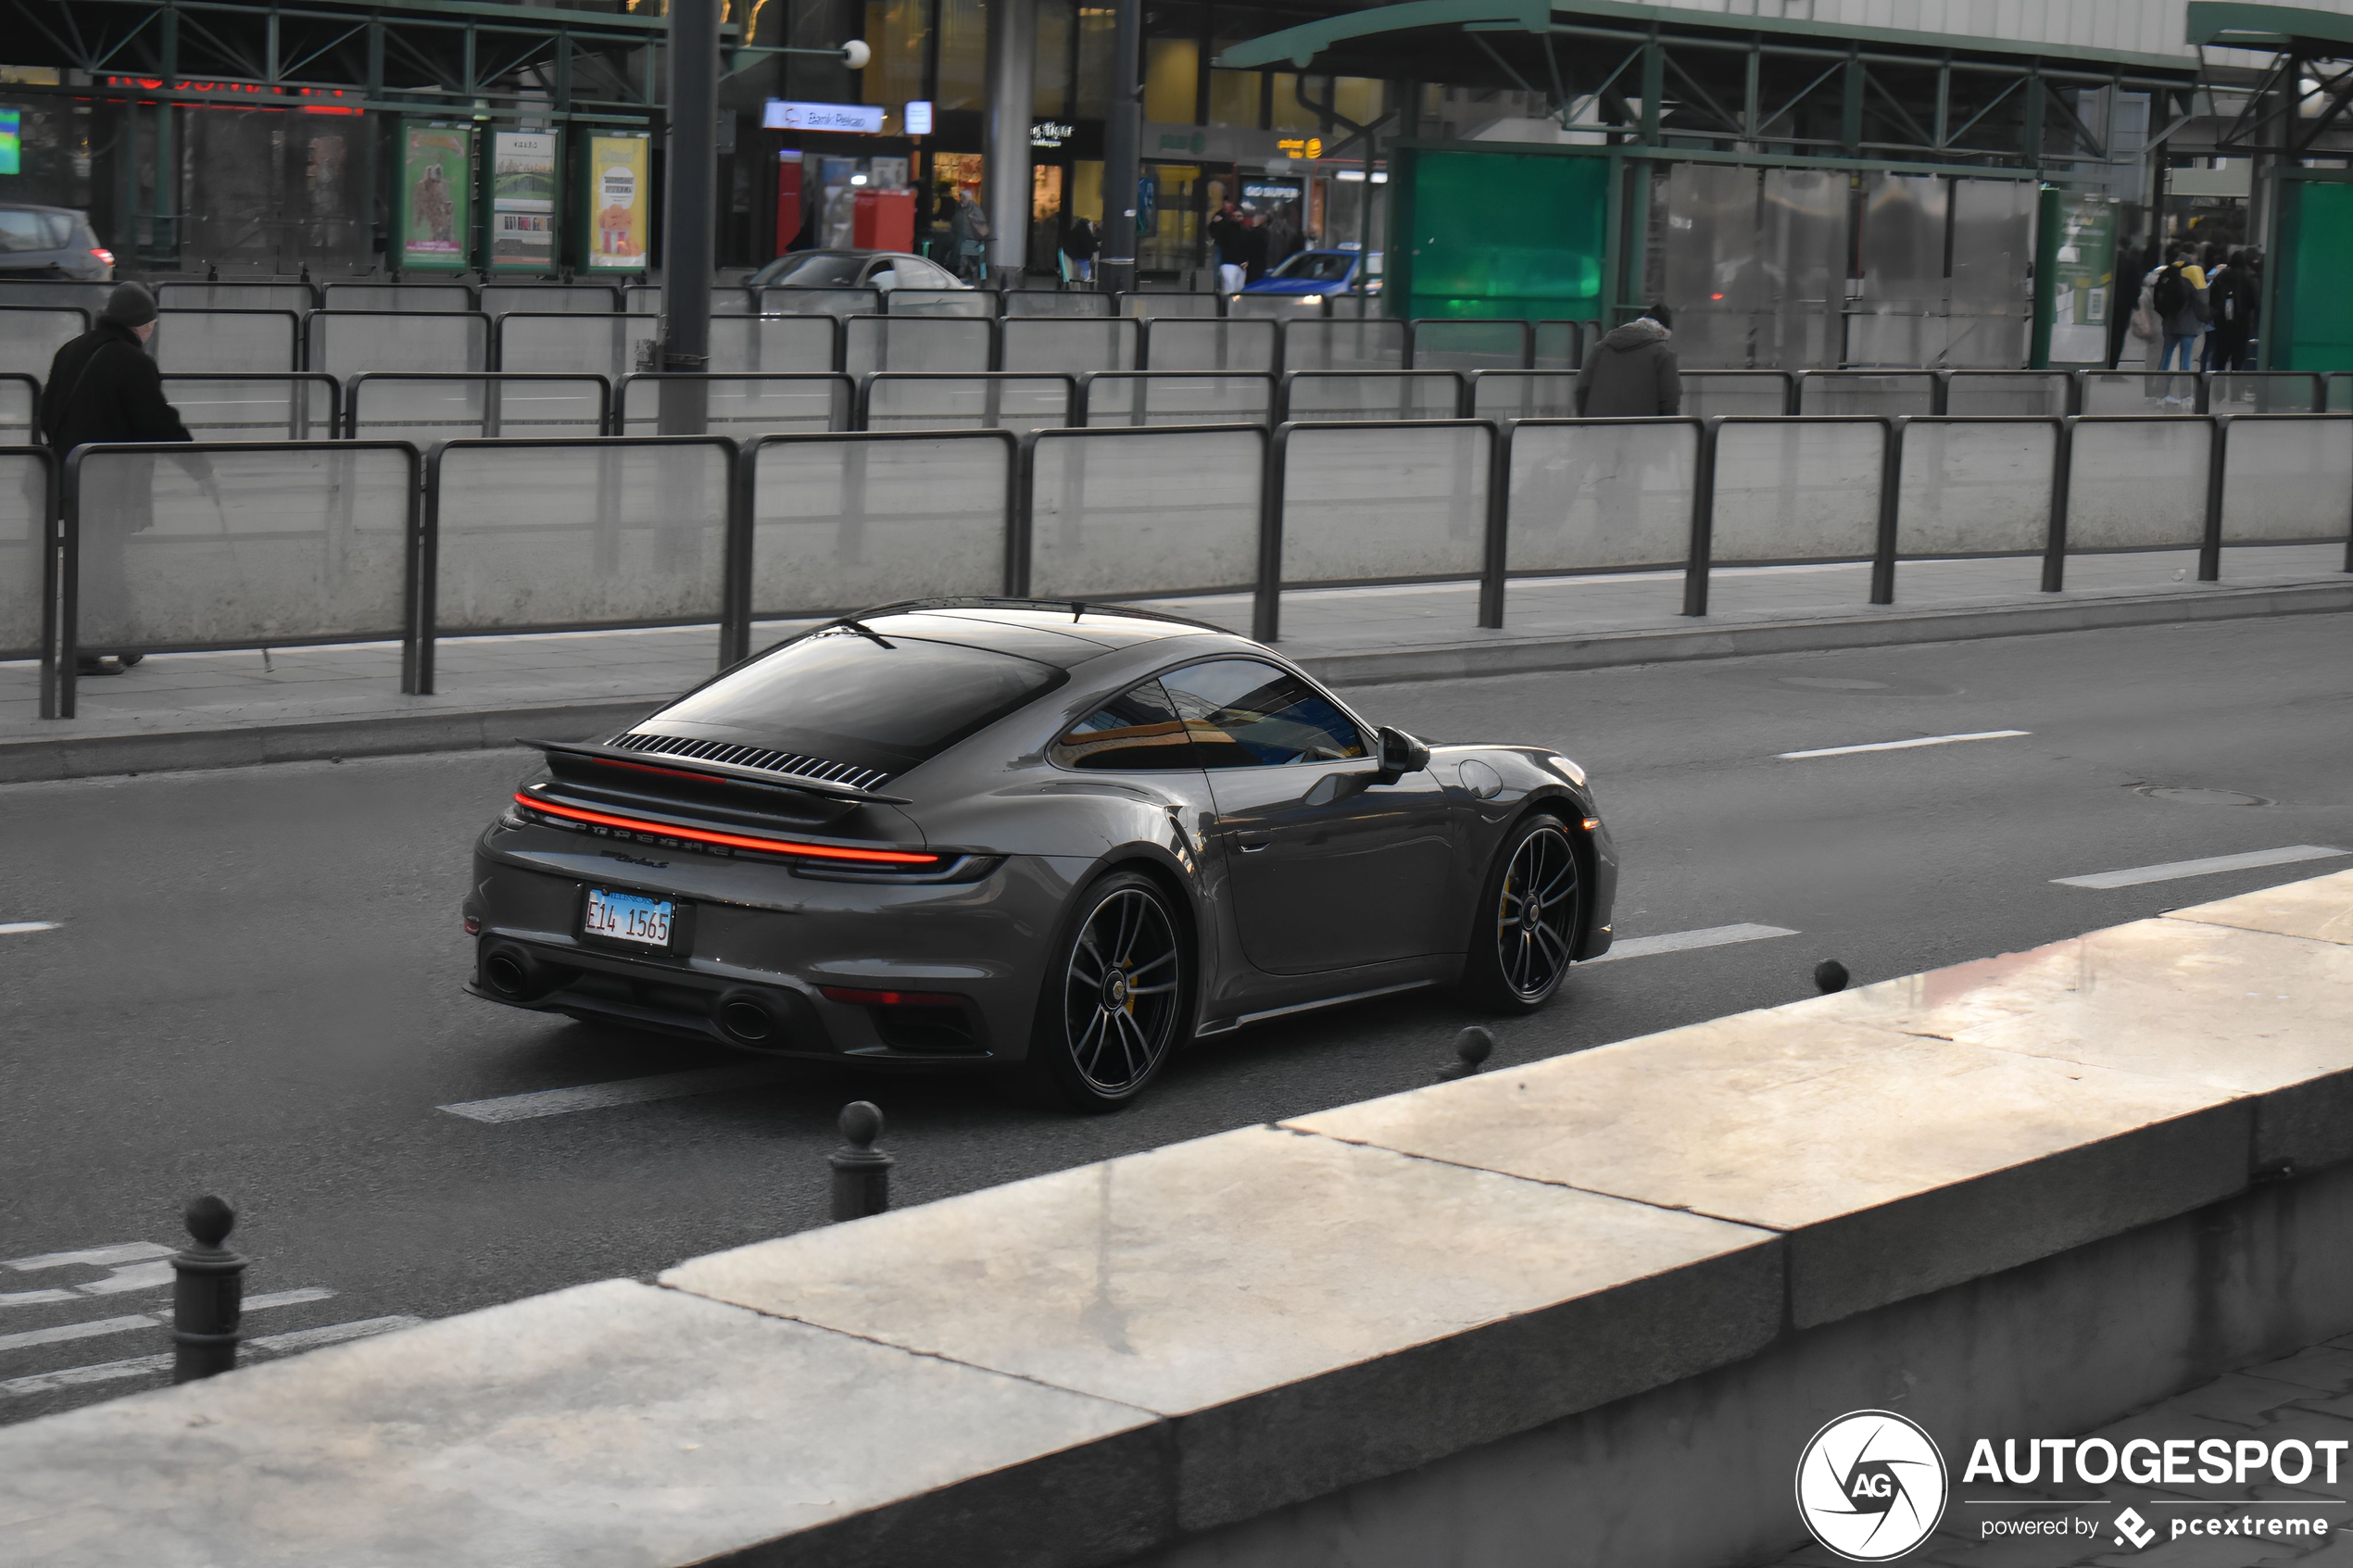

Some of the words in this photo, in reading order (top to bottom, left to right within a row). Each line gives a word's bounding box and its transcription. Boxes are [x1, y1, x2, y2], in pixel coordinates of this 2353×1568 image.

[575, 822, 730, 857] PORSCHE
[586, 900, 616, 933] E14
[626, 909, 669, 941] 1565
